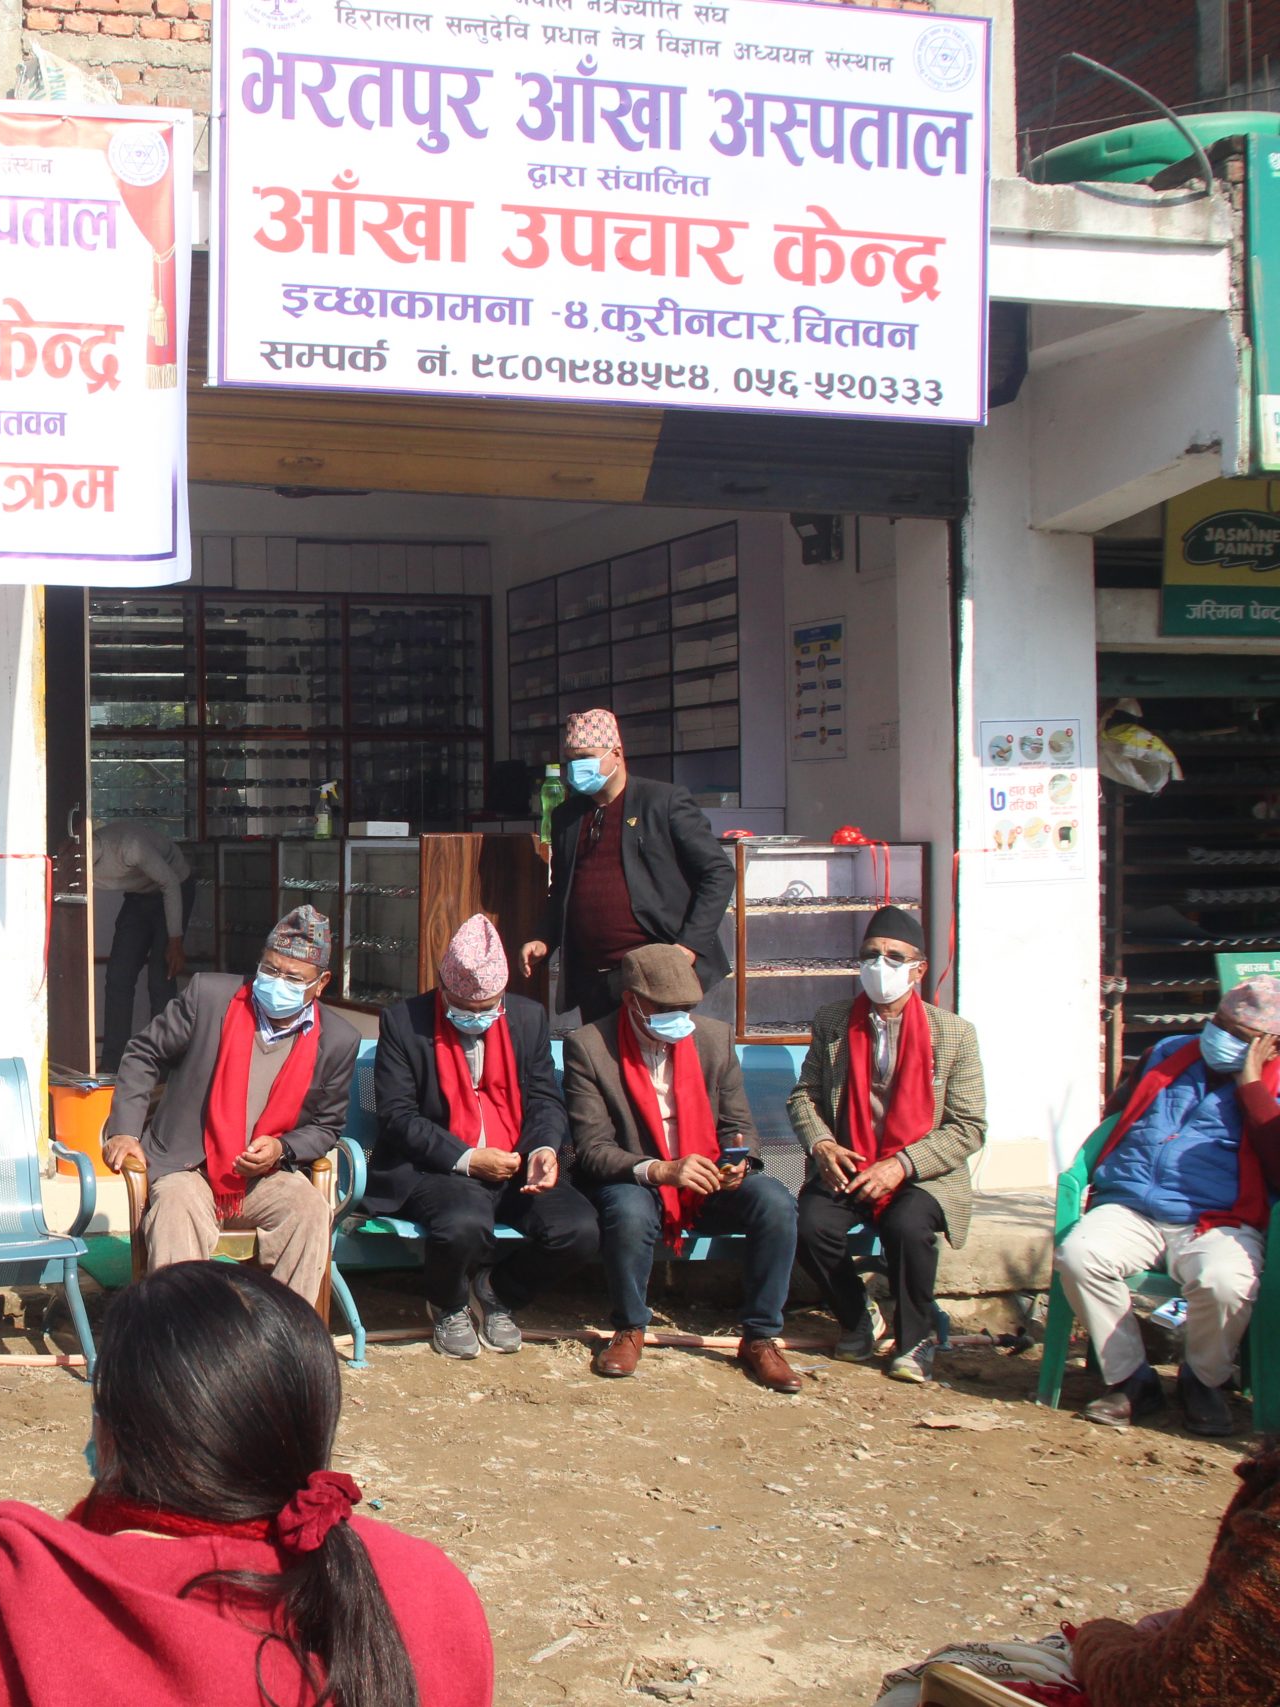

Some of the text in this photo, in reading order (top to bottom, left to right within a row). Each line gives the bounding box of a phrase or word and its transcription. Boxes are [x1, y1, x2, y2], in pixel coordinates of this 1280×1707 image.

[334, 0, 433, 33] हिरालाल
[541, 25, 600, 46] प्रधान
[611, 26, 645, 50] नेत्र
[656, 28, 722, 58] विज्ञान
[733, 42, 814, 66] अध्ययन
[825, 47, 894, 73] संस्थान
[241, 47, 973, 176] भरतपुर आँखा अस्पताल
[526, 160, 711, 197] द्वारा संचालित
[252, 168, 948, 304] आँखा उपचार केन्द्र
[281, 282, 534, 327] इच्छाकामना
[259, 339, 390, 372] सम्पर्क
[1204, 526, 1280, 543] JASMINE
[1214, 542, 1275, 556] PAINTS
